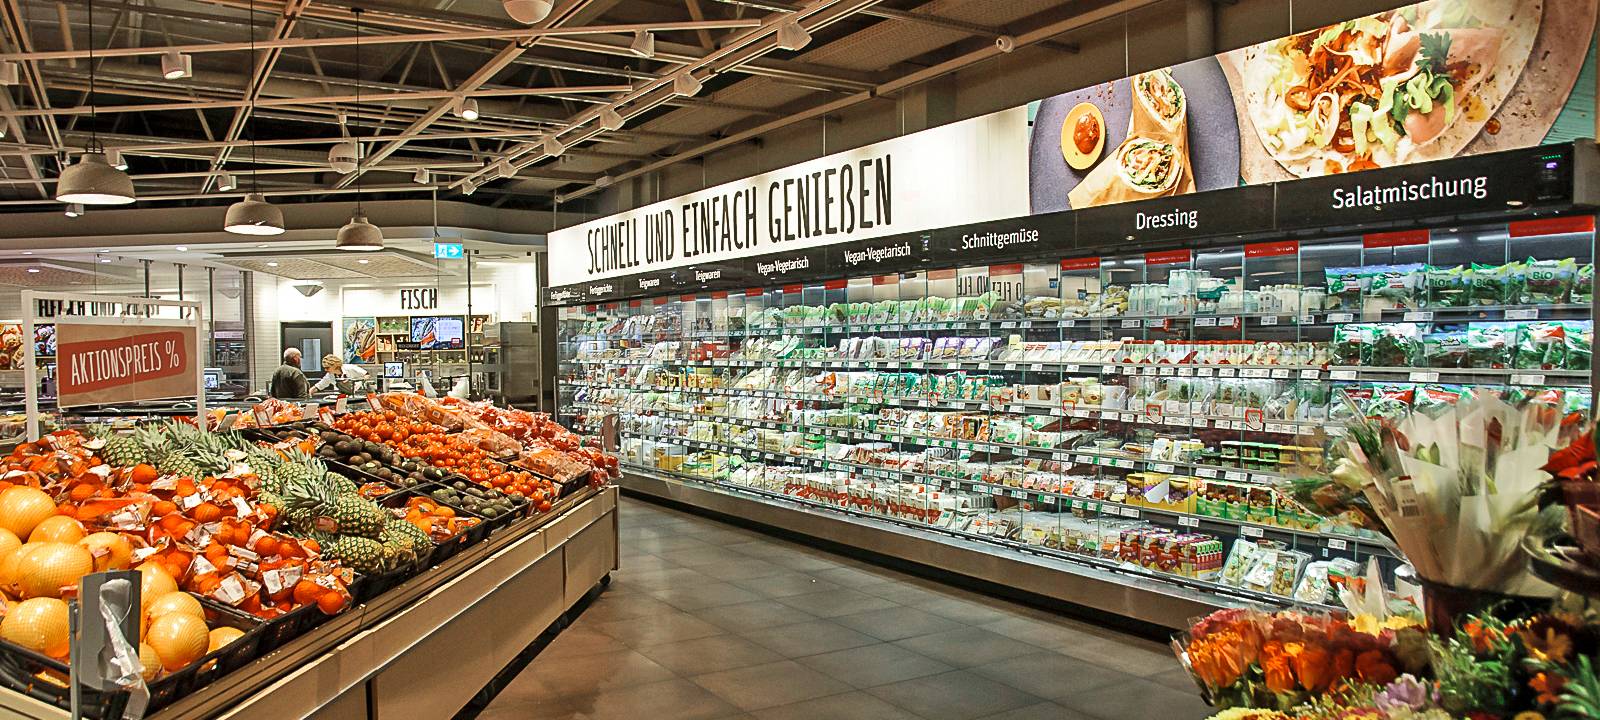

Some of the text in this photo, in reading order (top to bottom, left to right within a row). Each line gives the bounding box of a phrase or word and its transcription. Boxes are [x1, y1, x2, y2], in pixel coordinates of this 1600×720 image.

[1332, 173, 1488, 211] Salatmischung
[1136, 208, 1198, 230] Dressing
[587, 218, 640, 275] SCHNELL
[645, 209, 674, 264] UND
[683, 186, 758, 258] EINFACH
[961, 227, 1039, 250] Schnittgemüse
[844, 242, 911, 264] Vegan-Vegetarisch
[695, 269, 721, 283] Teigwaren
[757, 256, 809, 277] Vegan-Vegetarisch
[638, 278, 660, 290] Teigwaren
[400, 287, 438, 310] FISCH
[71, 340, 180, 386] AKTIONSPREIS %
